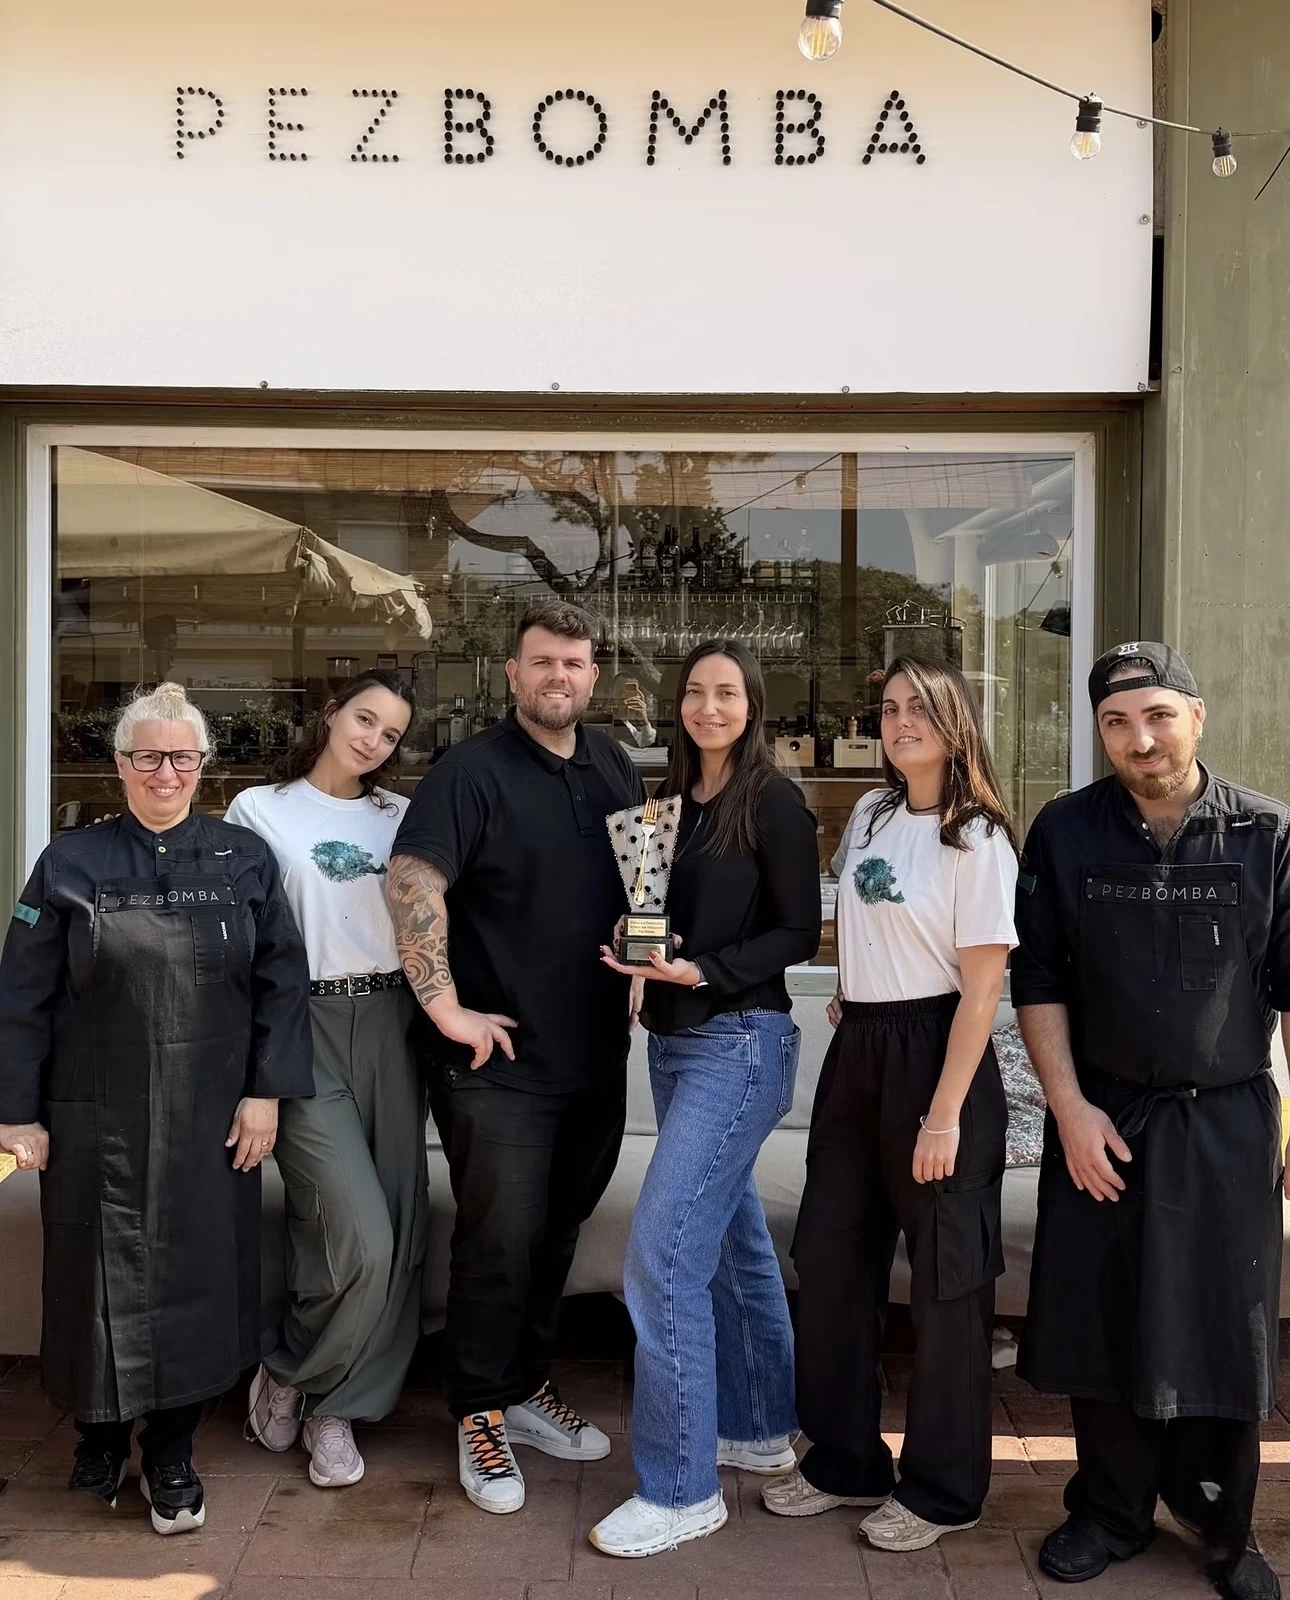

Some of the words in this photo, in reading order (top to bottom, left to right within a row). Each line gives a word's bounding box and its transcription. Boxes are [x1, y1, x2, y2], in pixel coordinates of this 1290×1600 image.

[176, 86, 926, 167] PEZBOMBA
[116, 890, 220, 907] PEZBOMBA
[1101, 884, 1218, 900] PEZBOMBA
